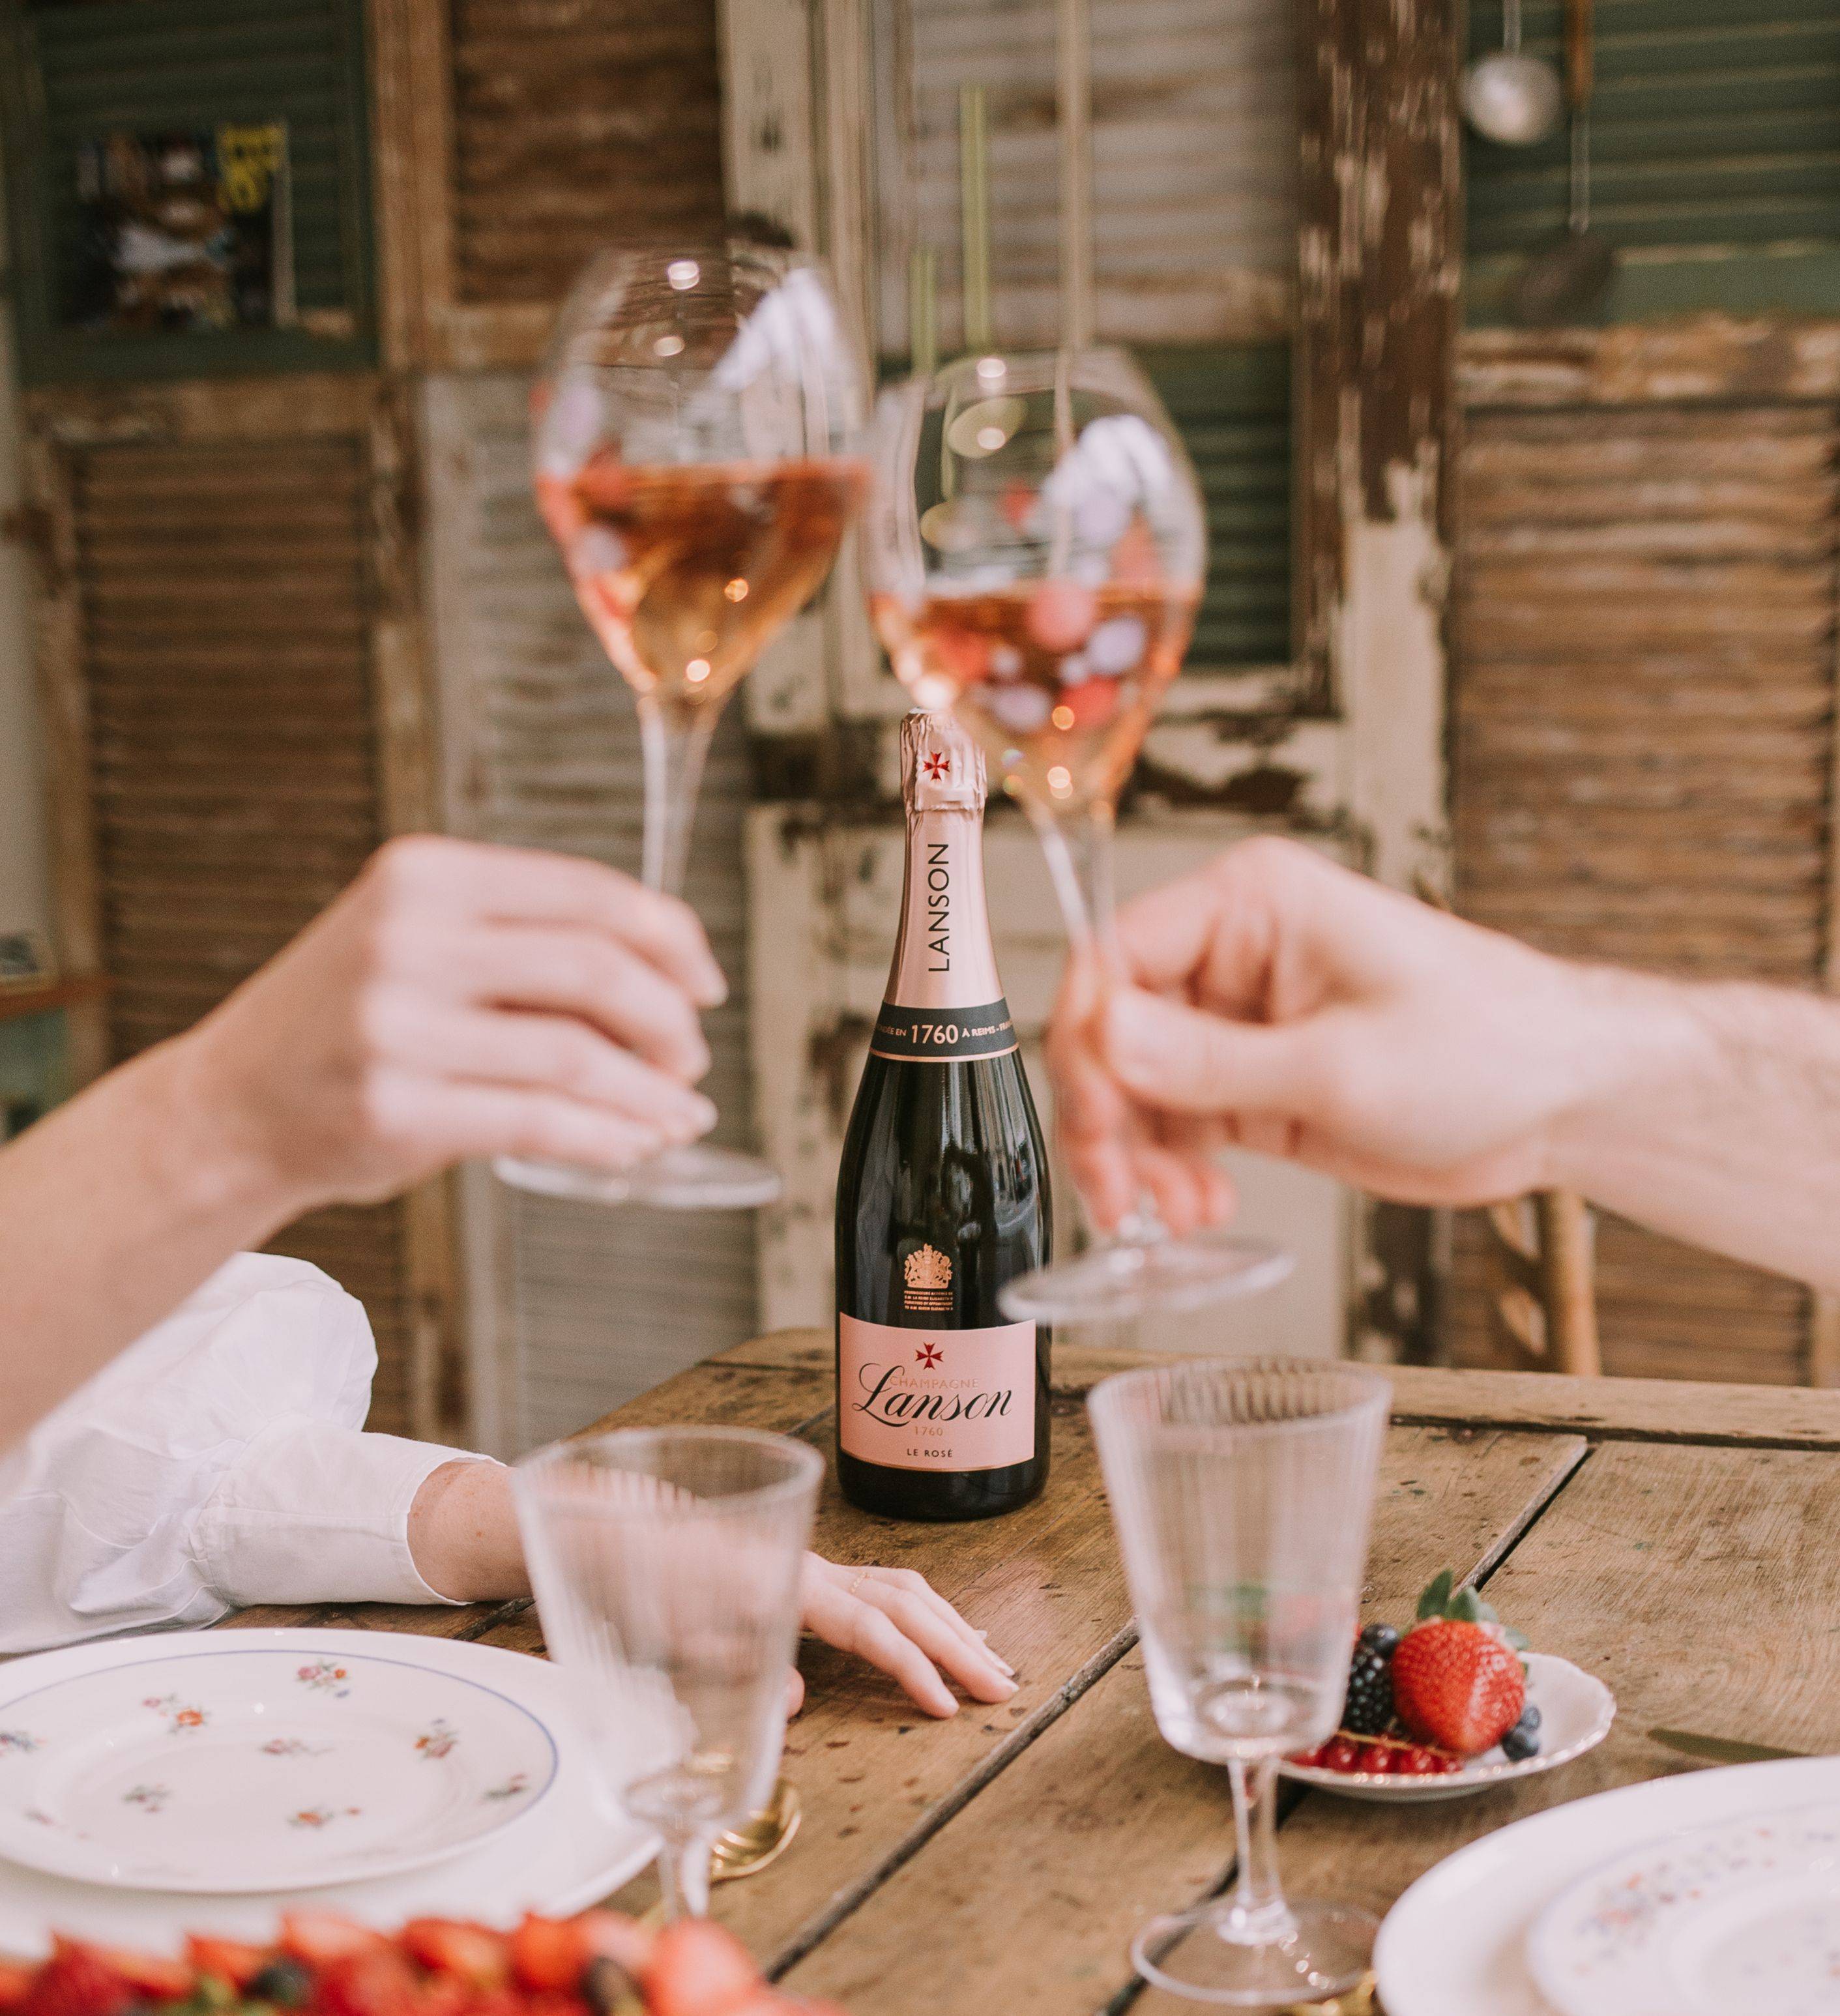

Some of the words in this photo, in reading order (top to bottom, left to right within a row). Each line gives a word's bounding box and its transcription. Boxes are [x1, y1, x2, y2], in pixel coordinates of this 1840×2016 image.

[927, 844, 950, 971] LANSON
[911, 1024, 959, 1044] 1760
[971, 1025, 996, 1036] REIMS
[890, 1375, 979, 1390] CHAMPAGNE
[852, 1363, 1012, 1427] Lanson
[914, 1426, 943, 1436] 1760
[924, 1448, 953, 1457] ROSÉ
